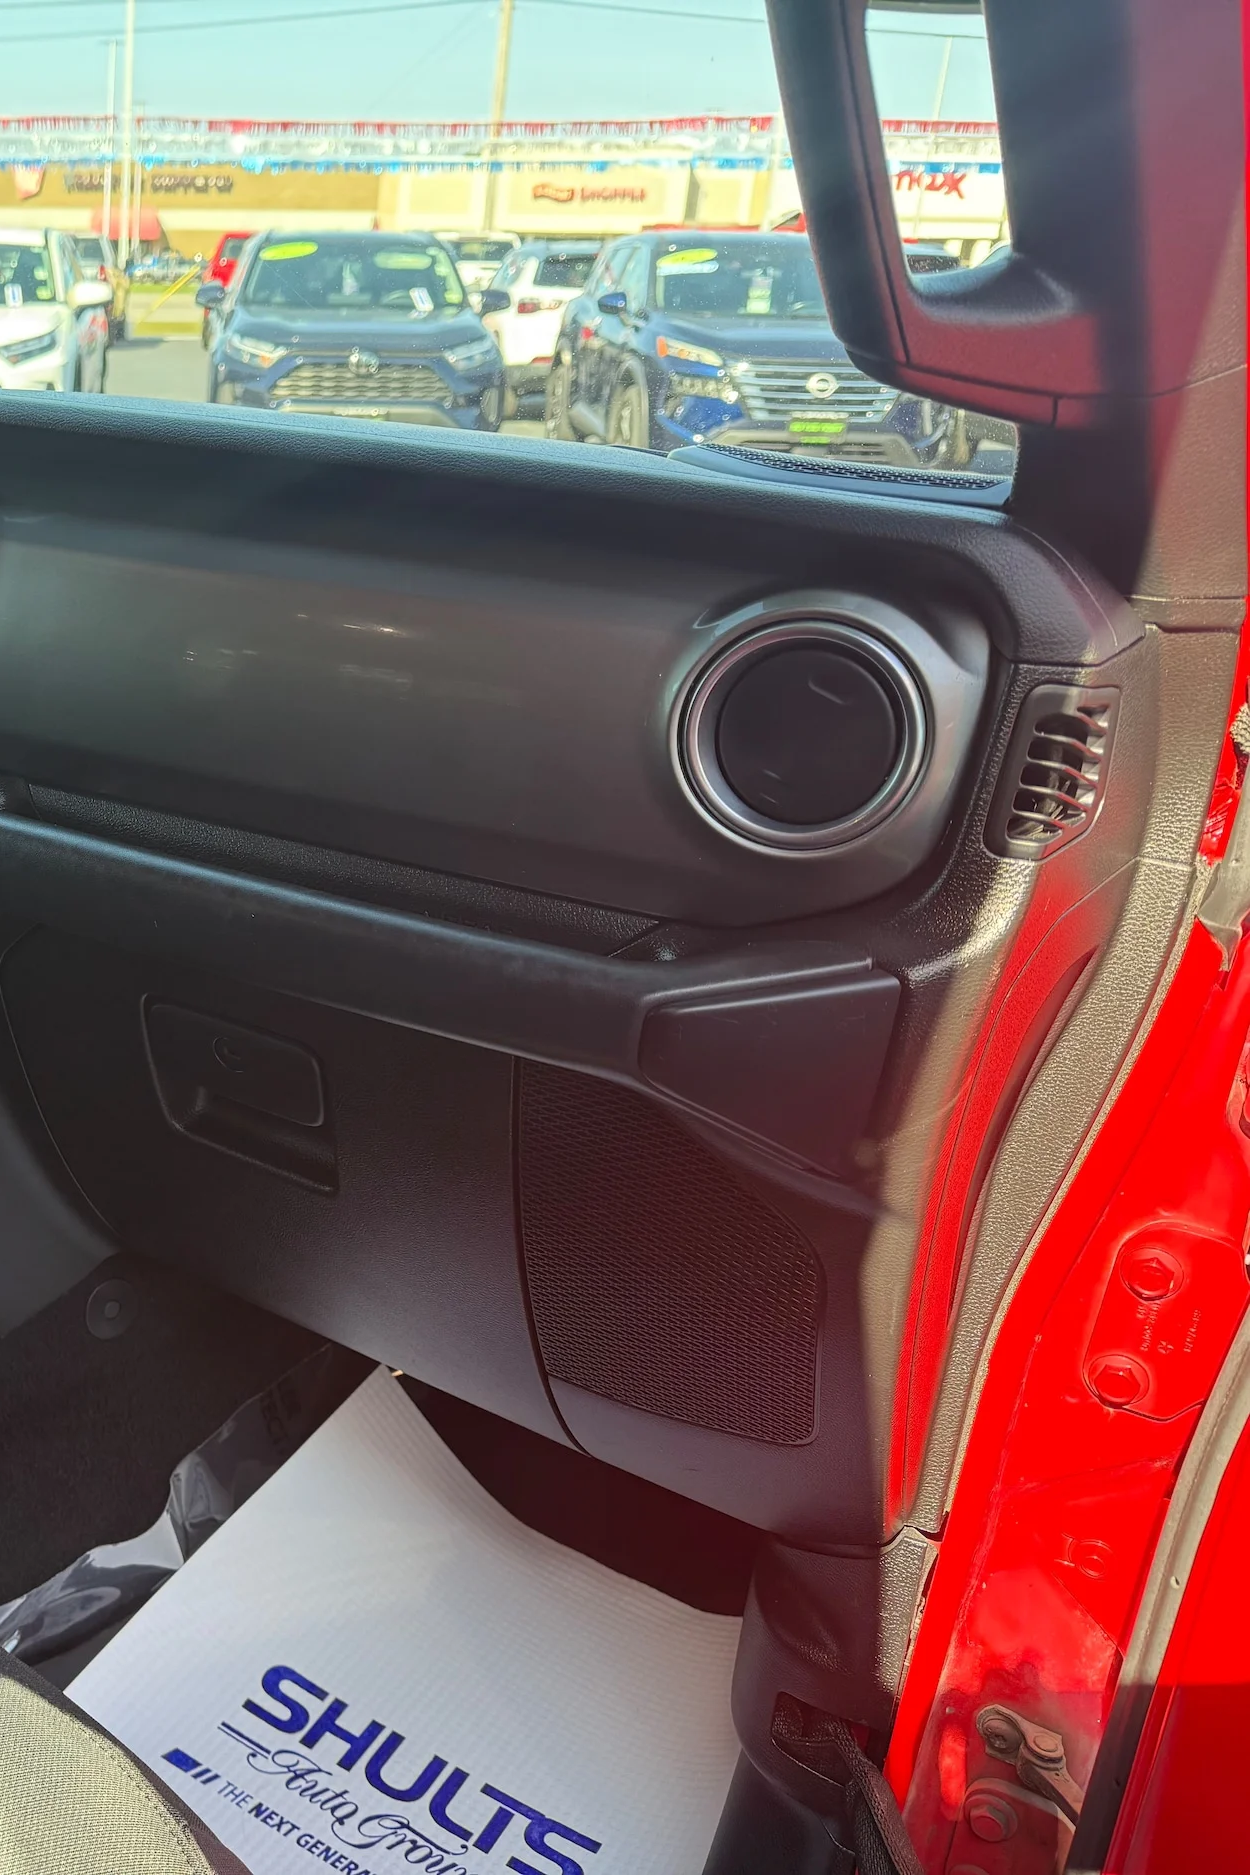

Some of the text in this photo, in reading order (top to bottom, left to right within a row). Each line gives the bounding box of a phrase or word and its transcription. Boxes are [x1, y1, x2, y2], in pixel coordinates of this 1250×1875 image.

[242, 1664, 603, 1875] SHULTS
[247, 1749, 359, 1826] Auto
[217, 1780, 254, 1809] THE
[247, 1802, 301, 1837] NEXT
